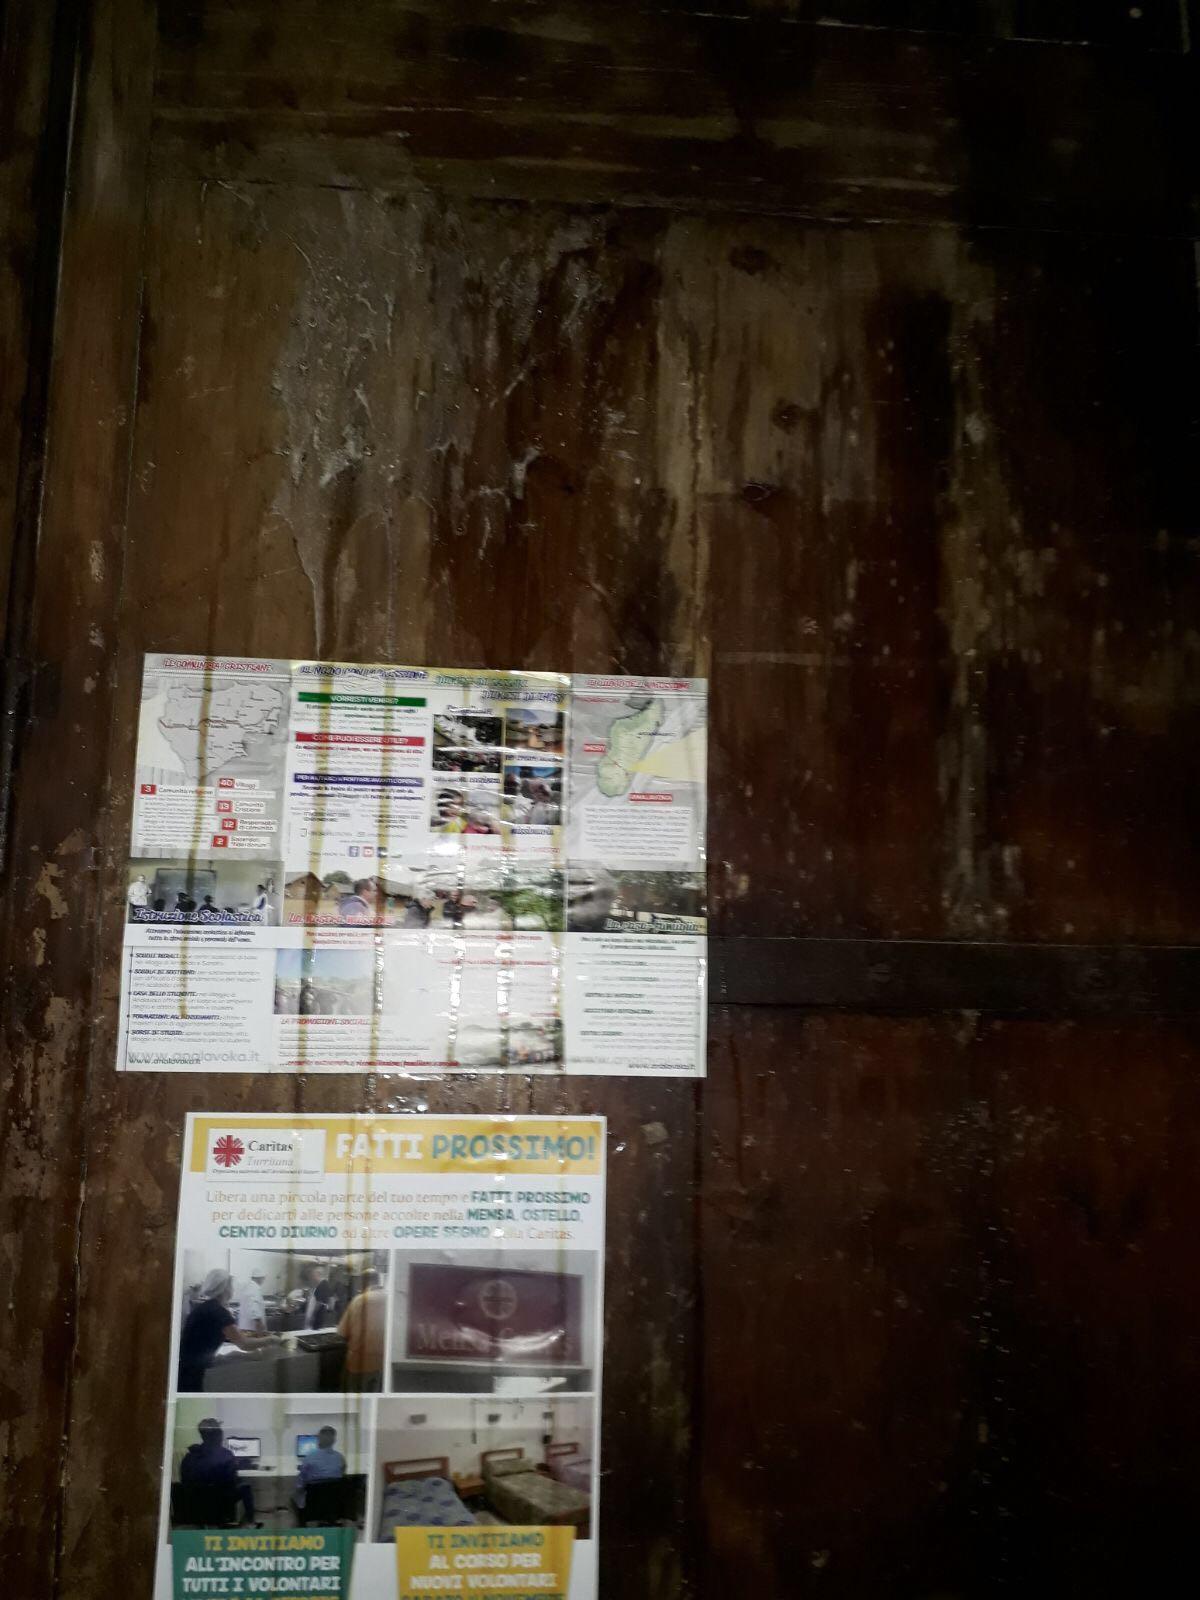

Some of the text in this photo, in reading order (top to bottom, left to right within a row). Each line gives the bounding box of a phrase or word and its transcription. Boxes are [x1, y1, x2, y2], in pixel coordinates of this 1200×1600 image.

[135, 908, 264, 922] Istruzione Scolastica
[248, 1140, 294, 1152] Caritas
[336, 1132, 596, 1161] FATTI PROSSIMO!
[206, 1190, 248, 1204] Libera
[250, 1193, 276, 1204] una
[279, 1191, 326, 1206] piccola
[330, 1193, 362, 1206] parte
[367, 1191, 388, 1204] del
[391, 1194, 413, 1204] tuo
[416, 1194, 458, 1206] tempo
[472, 1191, 513, 1204] FATTI
[516, 1192, 591, 1204] PROSSIMO
[212, 1210, 234, 1224] per
[237, 1208, 297, 1221] dedicarti
[300, 1209, 324, 1221] alle
[327, 1210, 380, 1224] persone
[383, 1210, 429, 1221] accolte
[432, 1209, 464, 1221] nella
[218, 1226, 276, 1238] CENTRO
[280, 1226, 338, 1238] DIURNO
[392, 1226, 438, 1238] OPERE
[442, 1226, 490, 1239] SEGNO
[492, 1228, 522, 1240] lla
[204, 1535, 325, 1550] TI INVITIAMO
[428, 1532, 544, 1548] TI INVITIAMO
[185, 1556, 340, 1572] ALL'INCONTRO PER
[429, 1553, 542, 1570] AL CORSO PER
[182, 1576, 342, 1592] TUTTI I VOLONTARI
[409, 1573, 558, 1590] NUOVI VOLONTARI
